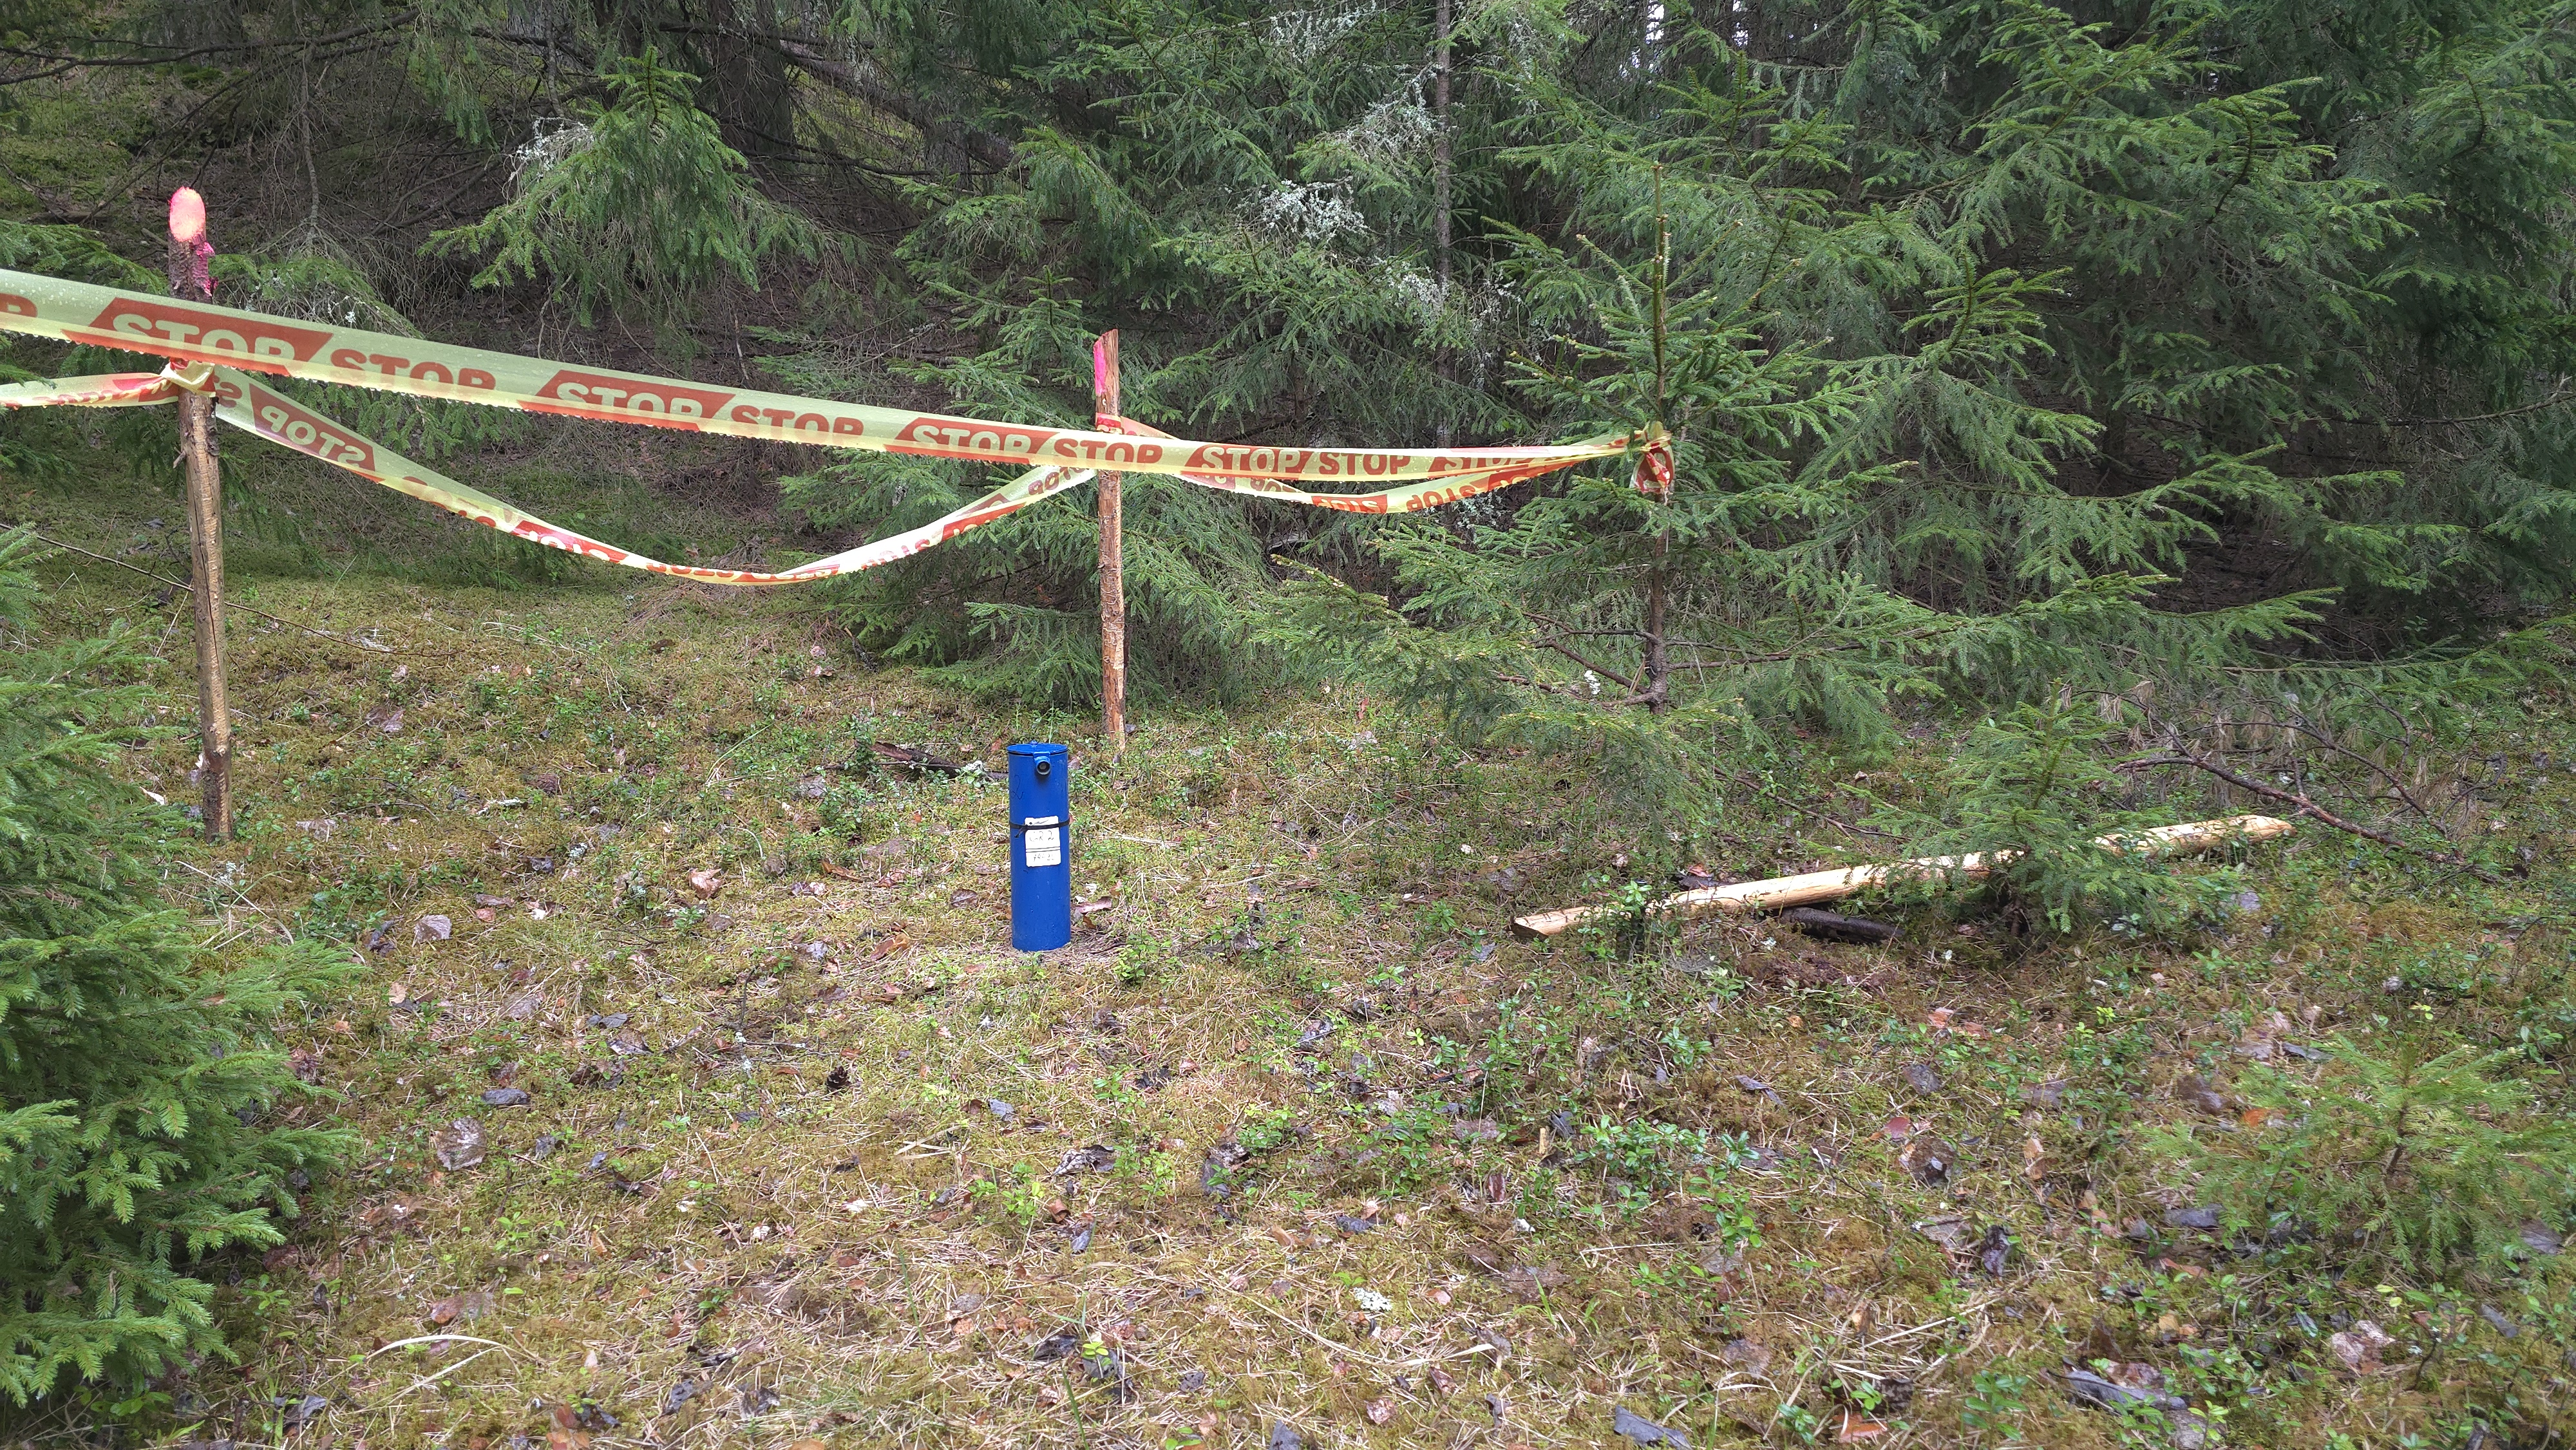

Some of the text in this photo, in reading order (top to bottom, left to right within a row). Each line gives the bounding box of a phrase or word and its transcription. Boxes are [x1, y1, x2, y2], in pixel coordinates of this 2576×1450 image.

[113, 314, 296, 362] STOP
[331, 348, 496, 390] STOP
[556, 382, 703, 418] STOP
[730, 404, 864, 436] STOP
[912, 424, 1032, 453] STOP
[1054, 438, 1163, 464] STOP
[1202, 446, 1300, 473] STOP
[1319, 452, 1410, 475] STOP
